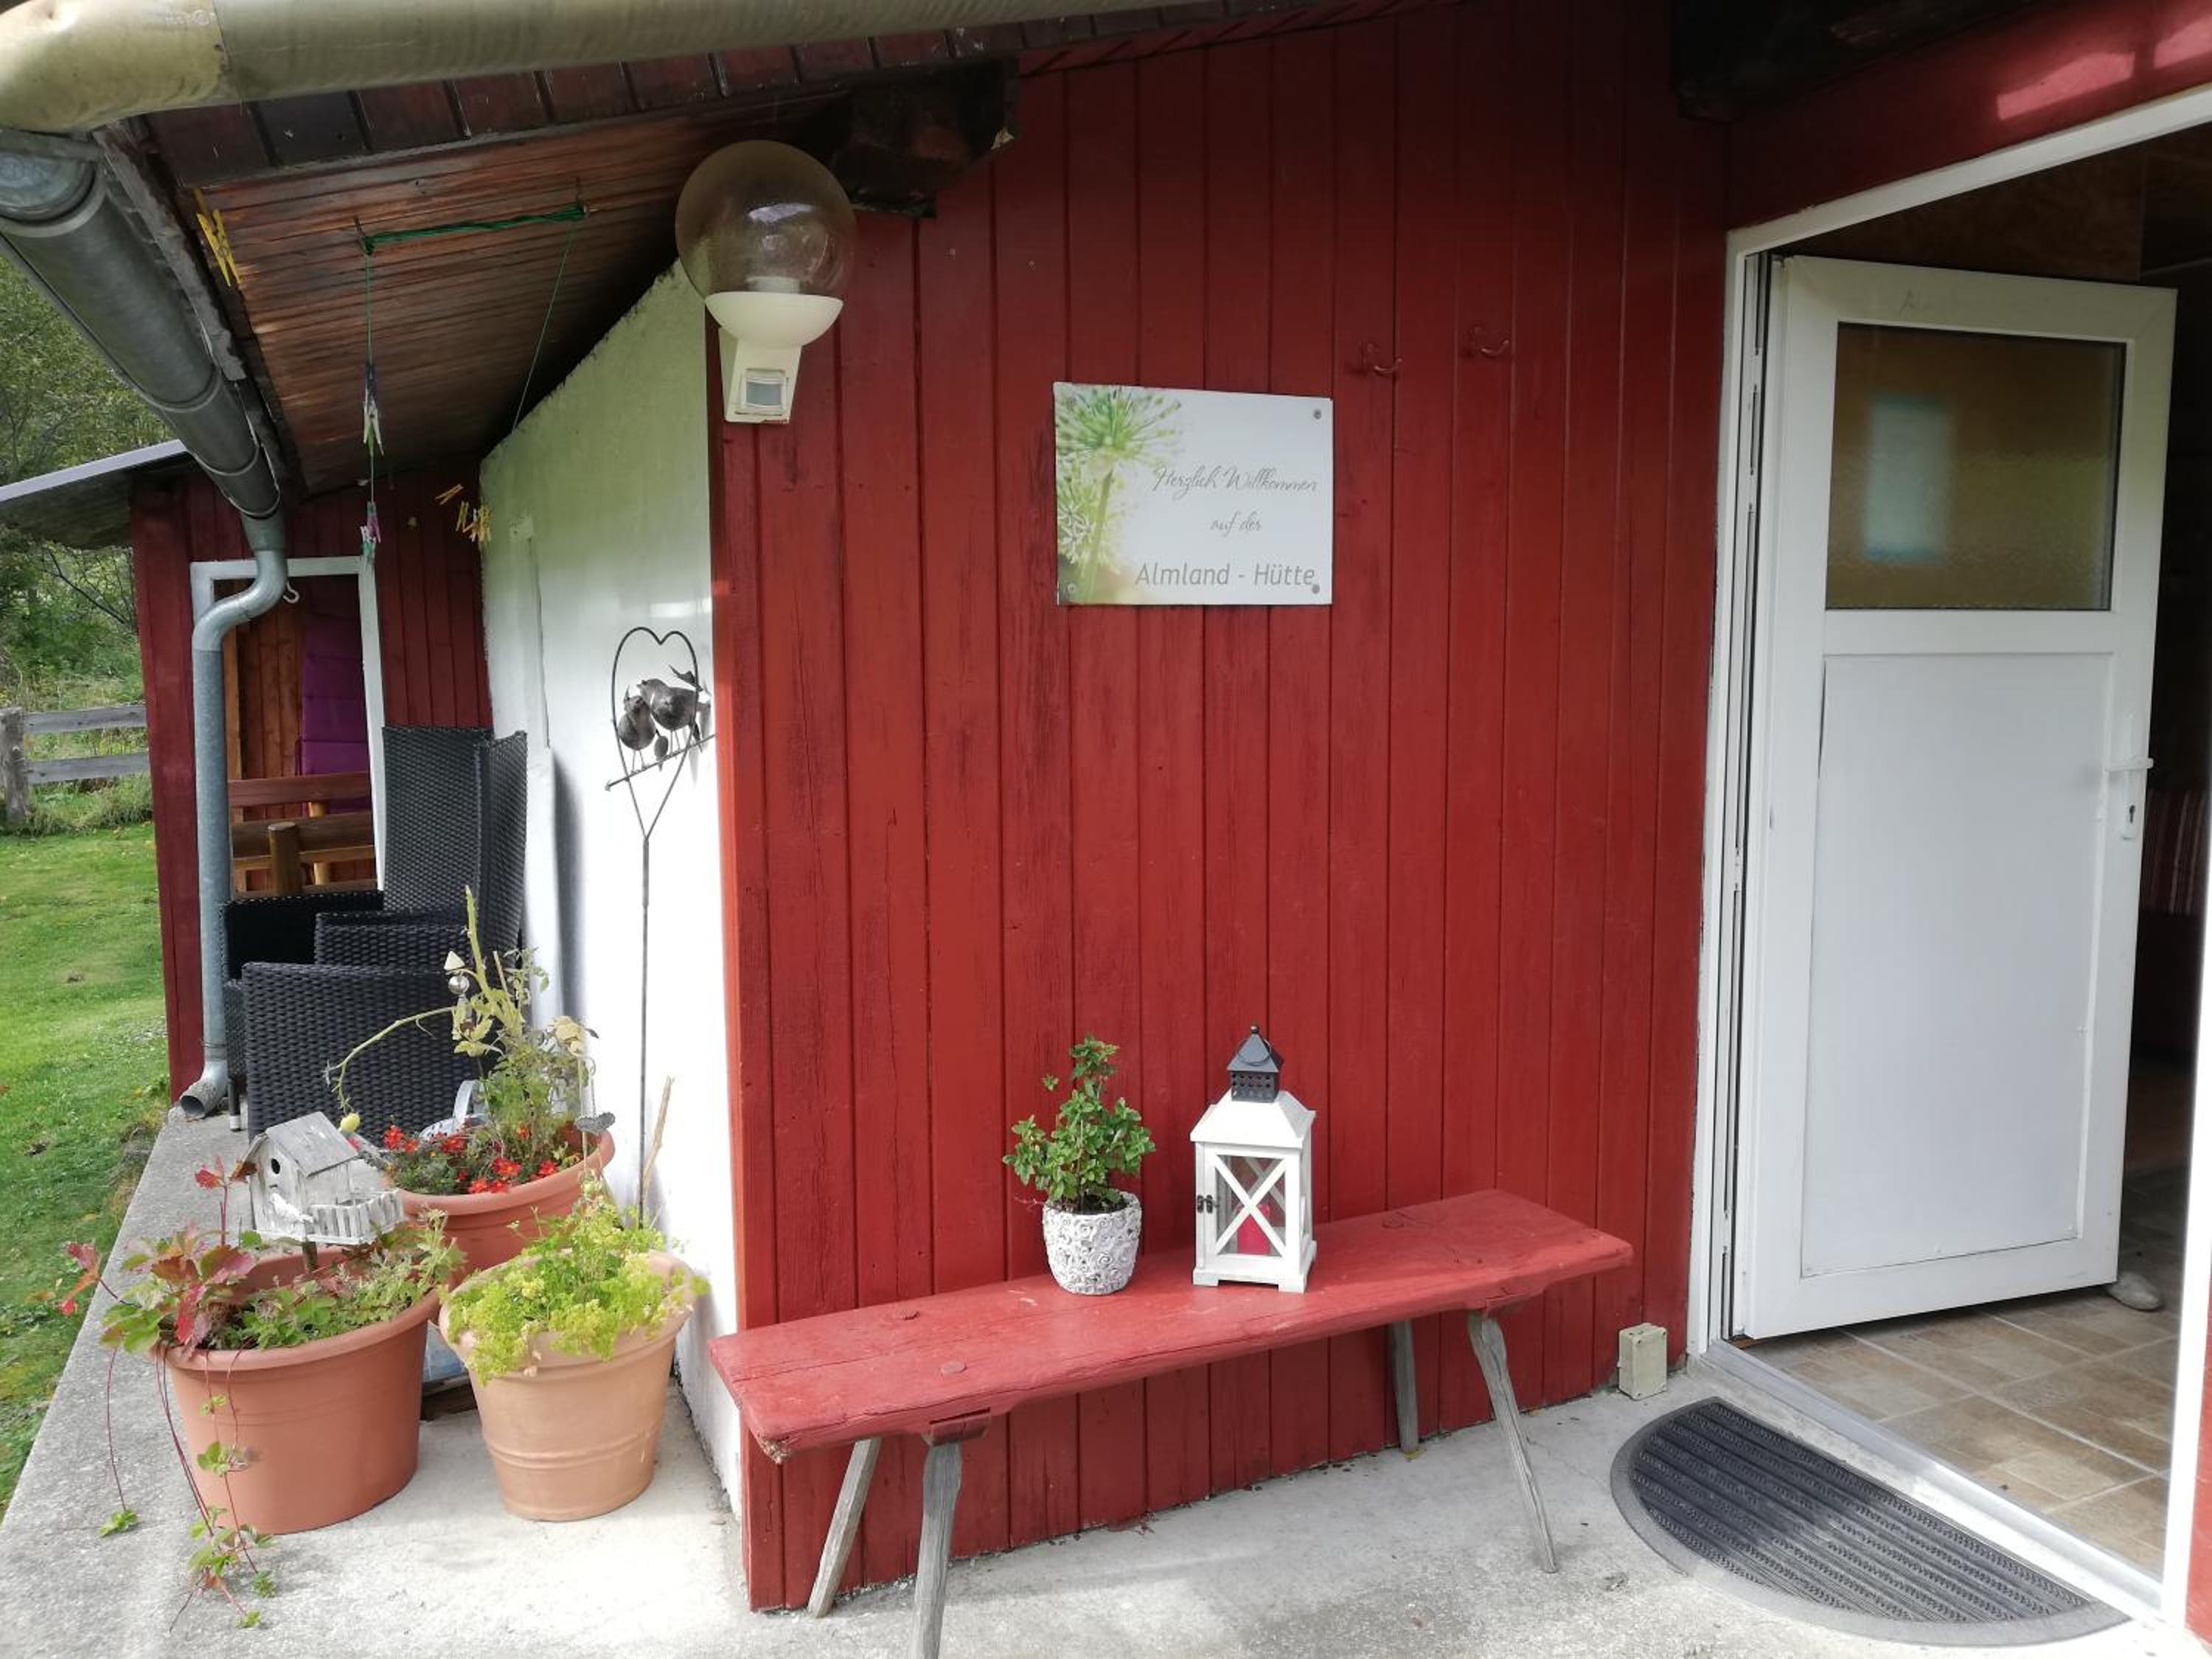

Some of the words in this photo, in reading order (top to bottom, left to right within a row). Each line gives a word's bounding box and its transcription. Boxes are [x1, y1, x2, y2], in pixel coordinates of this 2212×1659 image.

[1152, 465, 1221, 500] Herzlich
[1222, 466, 1318, 492] Willkommen
[1209, 510, 1240, 537] auf
[1239, 510, 1262, 531] der
[1135, 563, 1231, 585] Almland
[1254, 563, 1315, 585] Hütte
